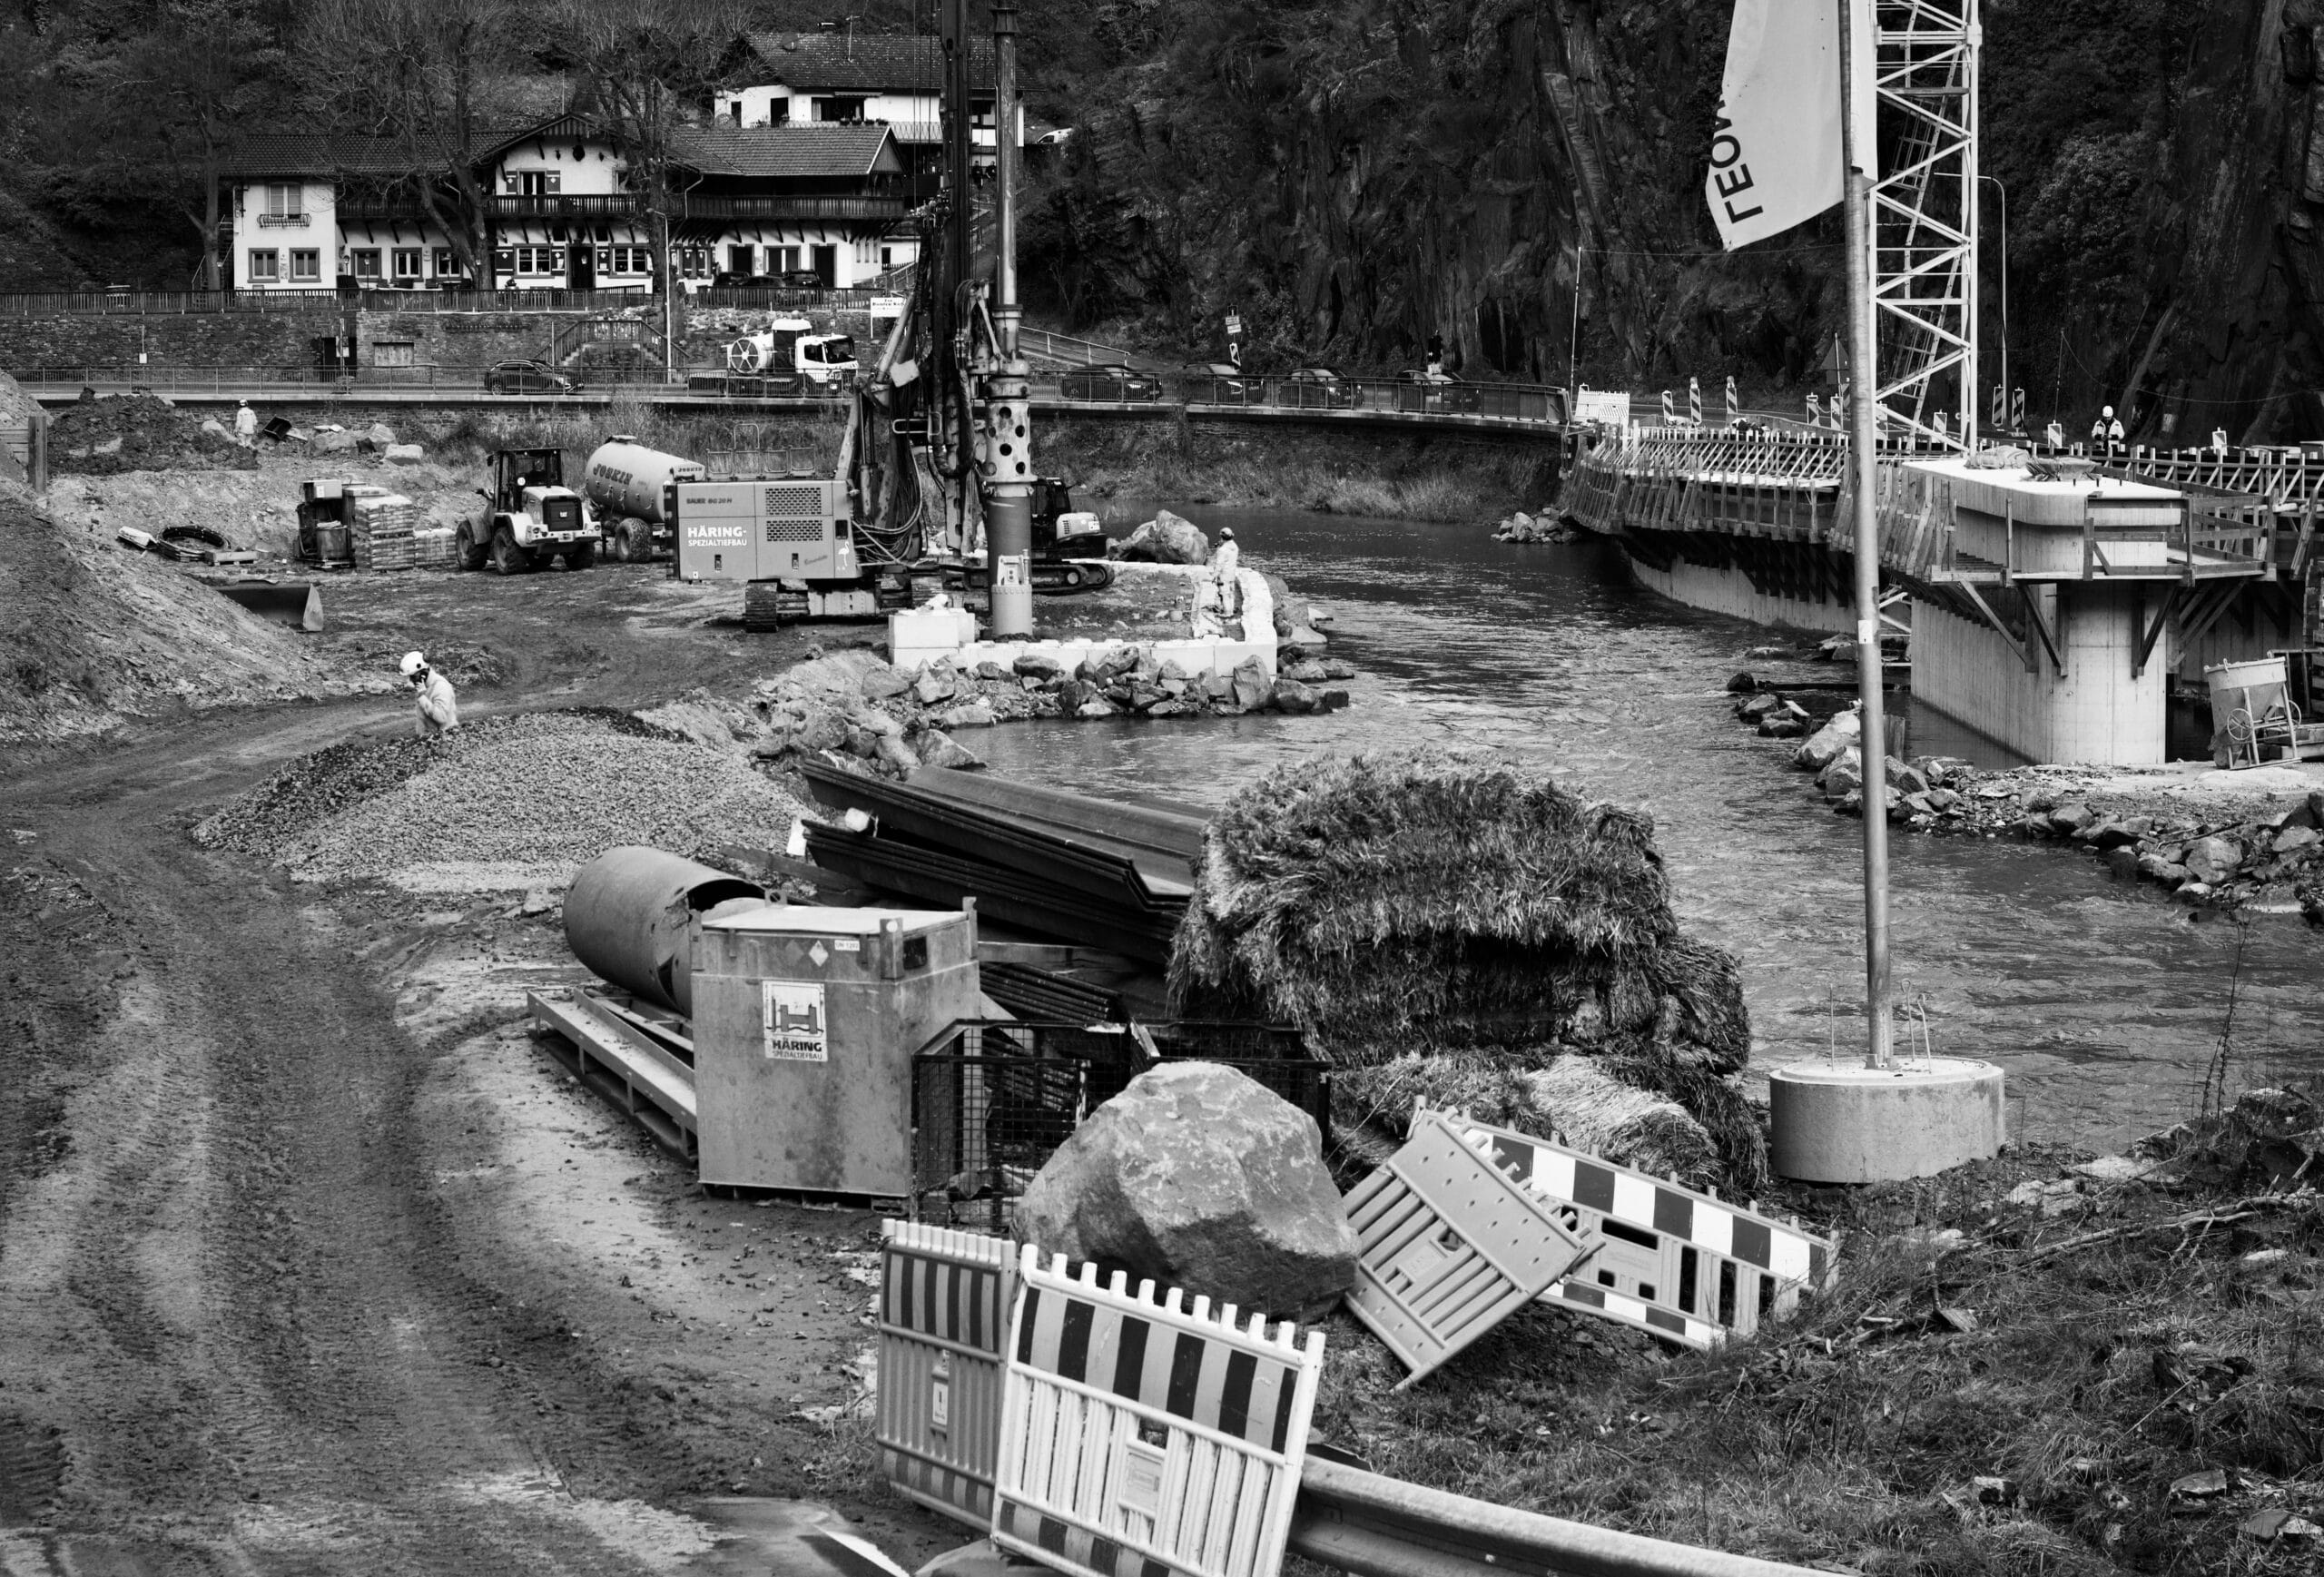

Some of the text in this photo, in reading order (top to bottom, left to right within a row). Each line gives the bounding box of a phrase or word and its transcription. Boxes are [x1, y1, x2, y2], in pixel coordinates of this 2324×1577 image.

[688, 538, 747, 547] SPEZIALTIEFBAU
[773, 1038, 822, 1052] HÄRING
[773, 1050, 822, 1060] SPEZIALTIEFBAU
